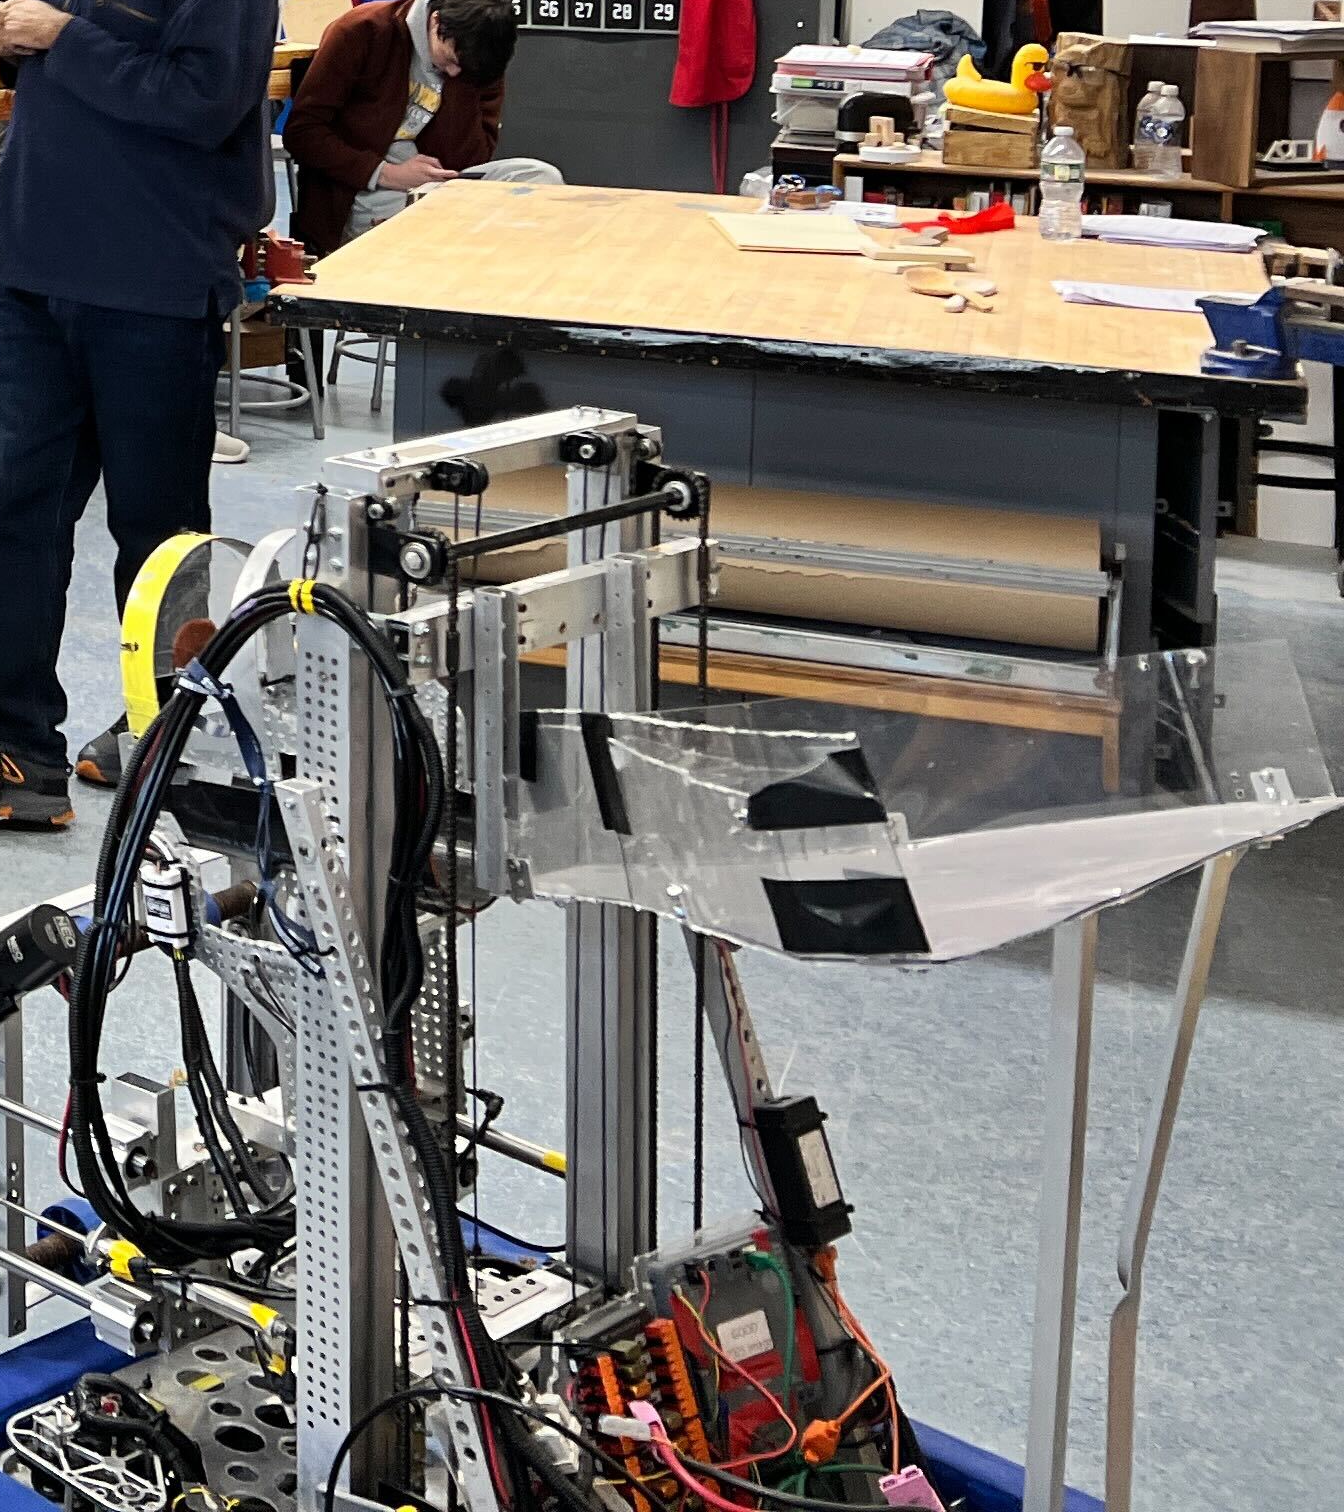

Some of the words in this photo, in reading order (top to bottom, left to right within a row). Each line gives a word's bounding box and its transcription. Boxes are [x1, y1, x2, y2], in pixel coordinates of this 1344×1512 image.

[539, 0, 559, 18] 26
[574, 2, 594, 19] 27
[612, 3, 633, 20] 28
[653, 4, 674, 21] 29
[53, 915, 76, 948] NEO
